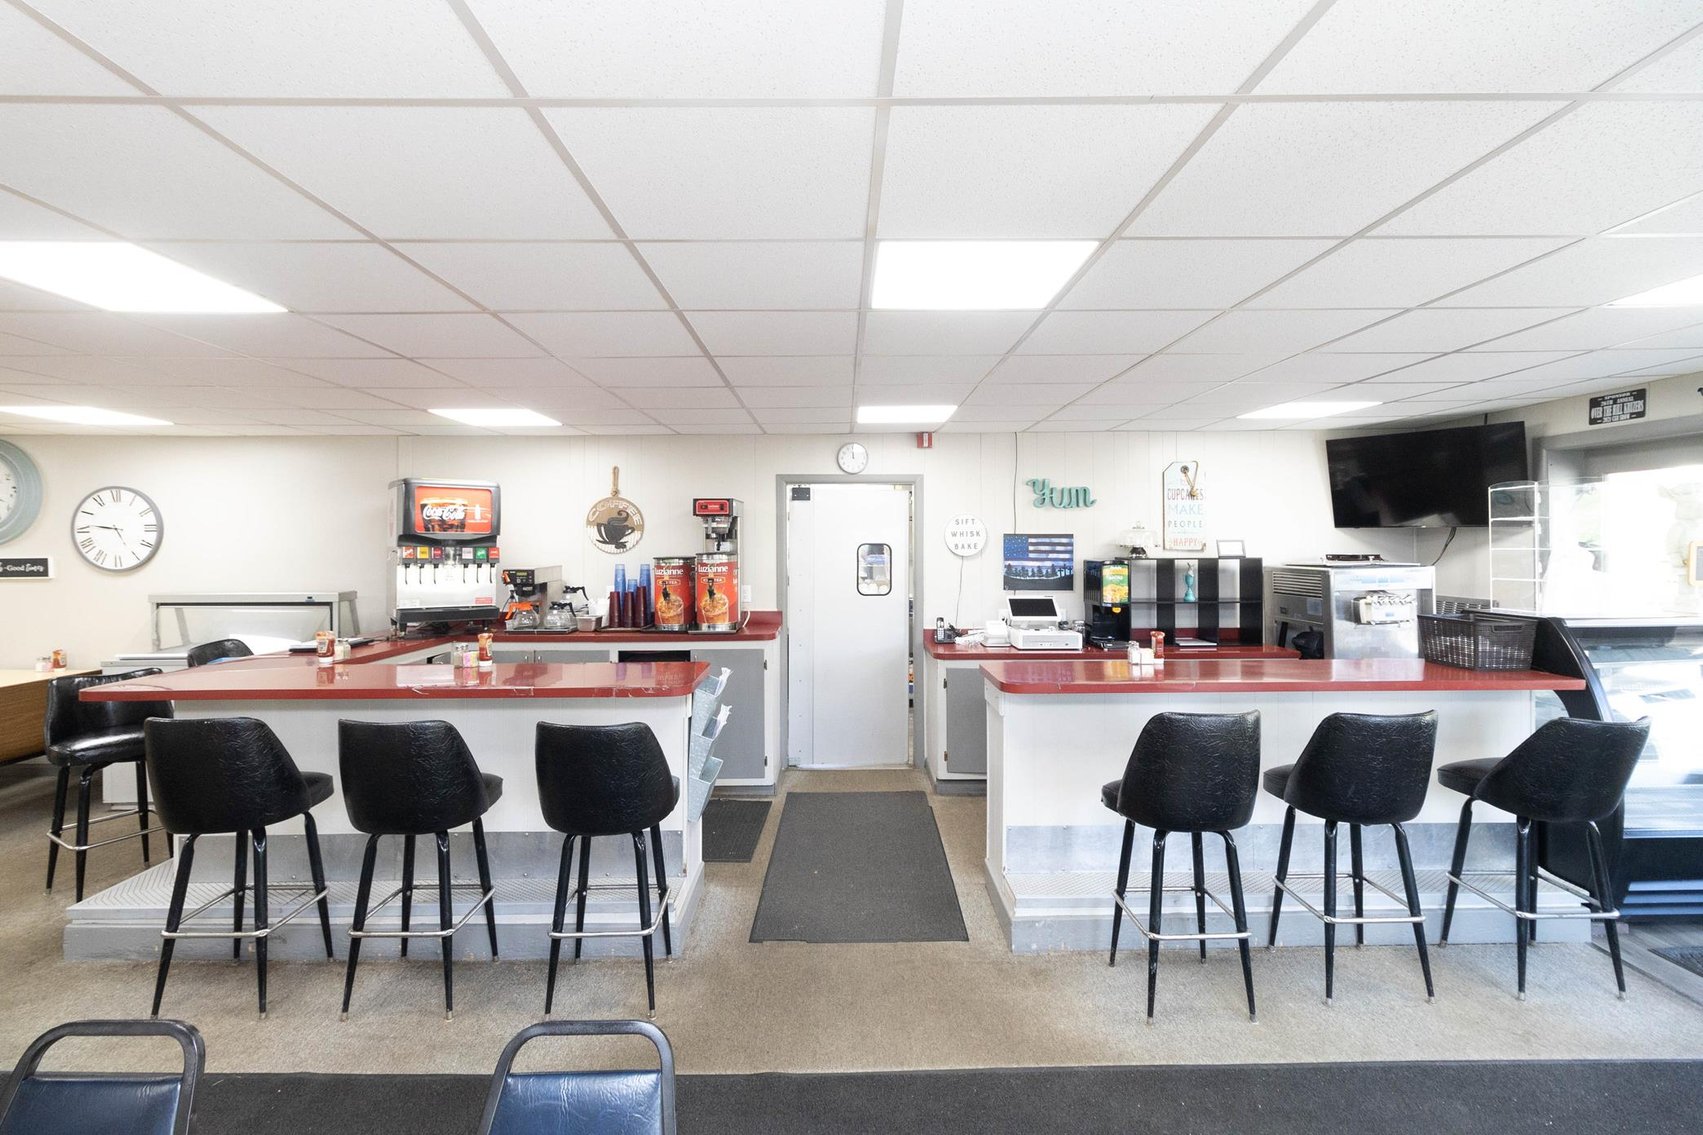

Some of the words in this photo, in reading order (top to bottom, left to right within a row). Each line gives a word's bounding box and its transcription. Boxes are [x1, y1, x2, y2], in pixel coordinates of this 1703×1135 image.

[1591, 406, 1603, 419] OVER
[1603, 405, 1612, 417] THE
[1026, 479, 1097, 509] Yum
[588, 499, 643, 526] COFFEE
[1167, 503, 1203, 516] MAKE
[955, 518, 975, 526] SIFT
[1168, 520, 1203, 528] PEOPLE
[950, 530, 981, 538] WHISK
[954, 542, 978, 550] BAKE
[1172, 536, 1198, 547] HAPPY
